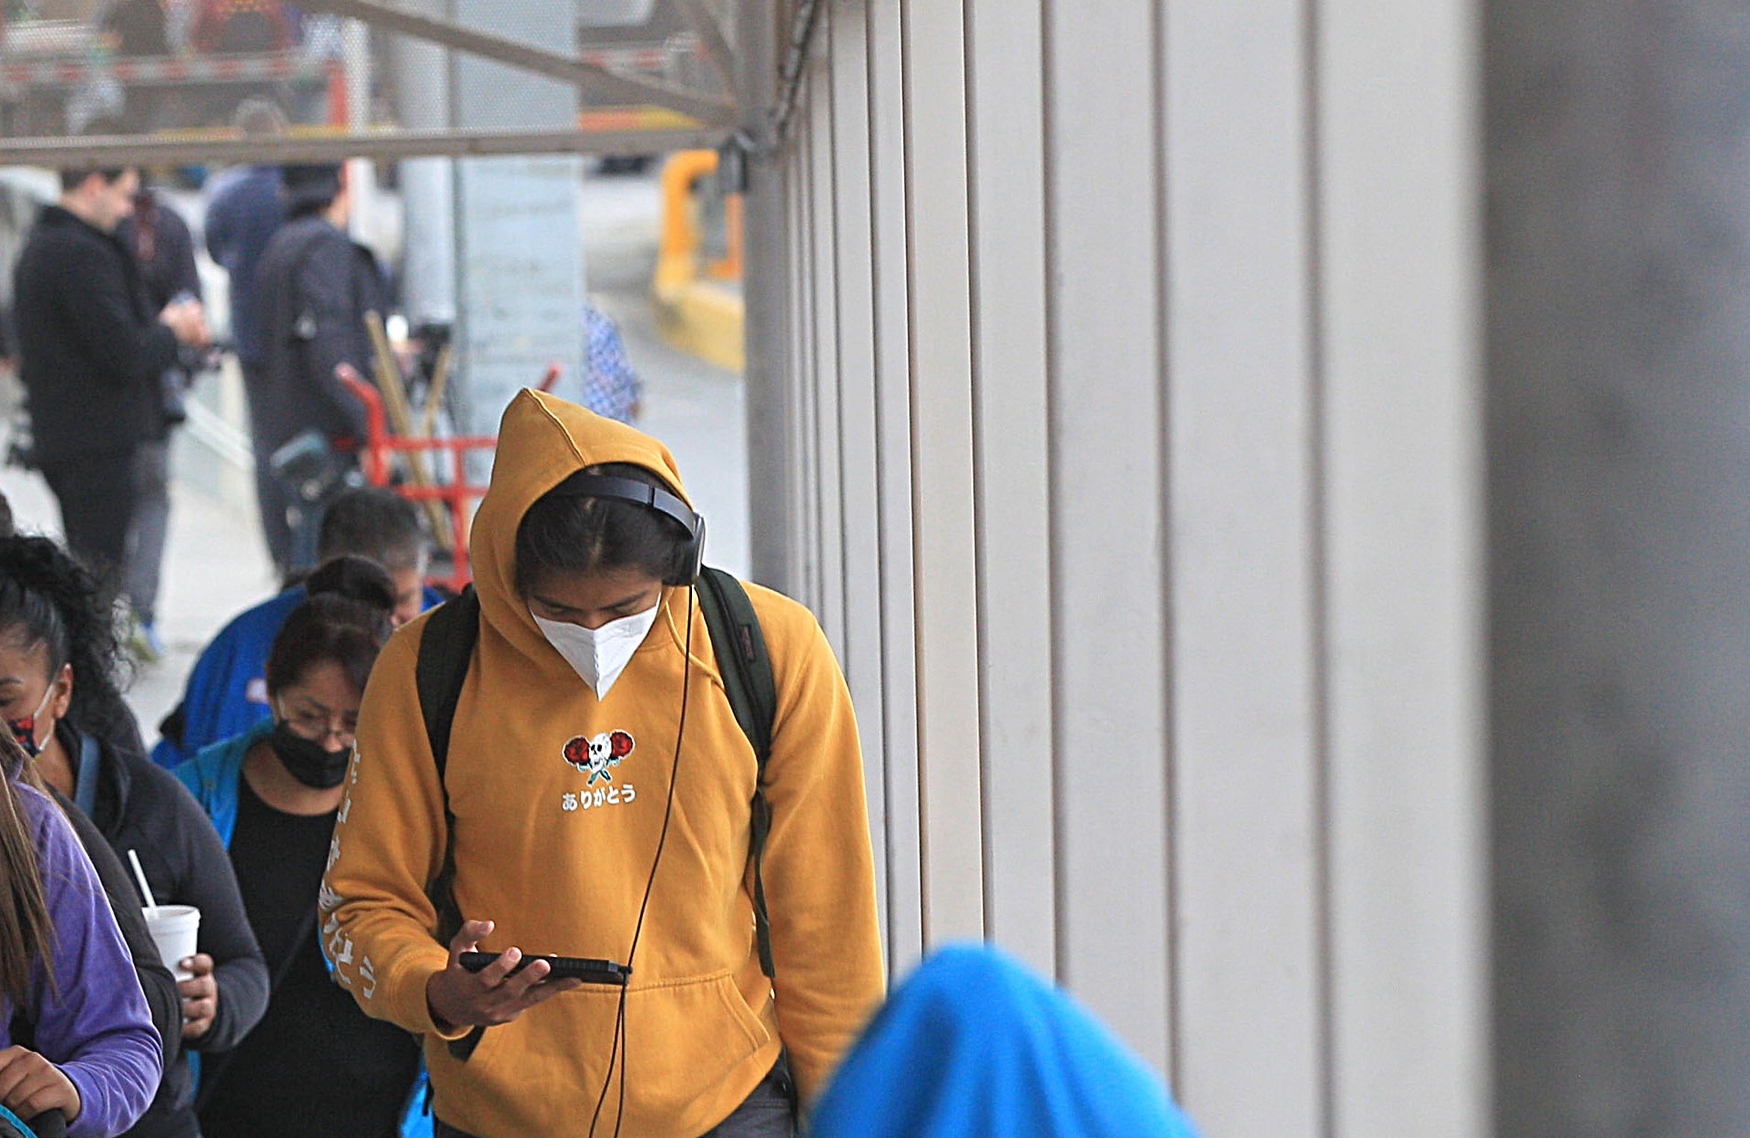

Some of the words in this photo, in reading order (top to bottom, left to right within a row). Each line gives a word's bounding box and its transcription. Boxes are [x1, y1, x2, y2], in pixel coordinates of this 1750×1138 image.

[562, 784, 636, 811] ありがとう
